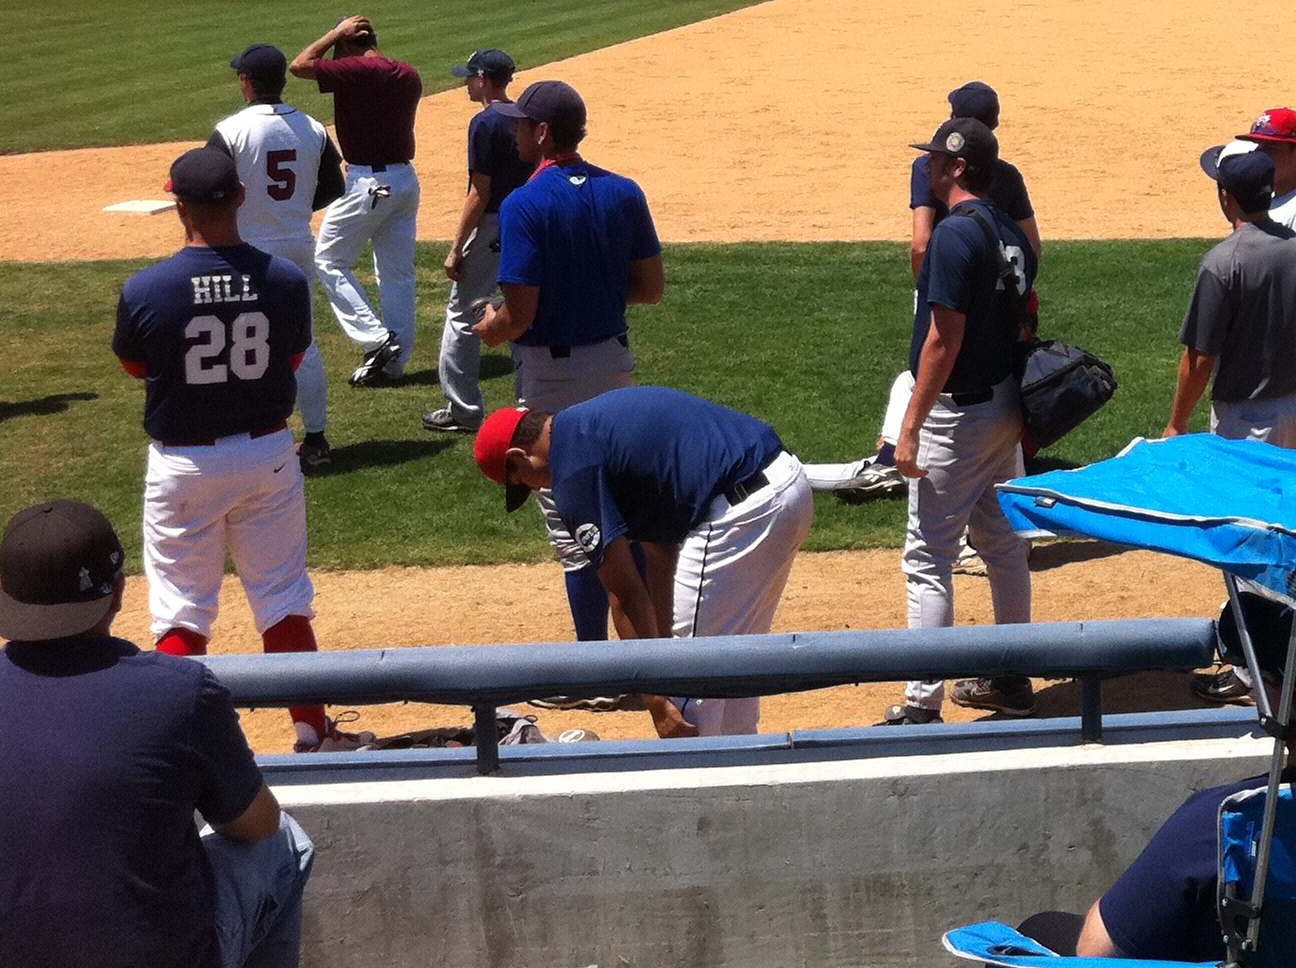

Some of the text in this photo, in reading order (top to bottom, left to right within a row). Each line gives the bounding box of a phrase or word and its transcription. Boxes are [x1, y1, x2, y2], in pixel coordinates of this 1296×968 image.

[266, 149, 297, 201] 5
[190, 274, 259, 305] HILL
[184, 310, 271, 385] 28
